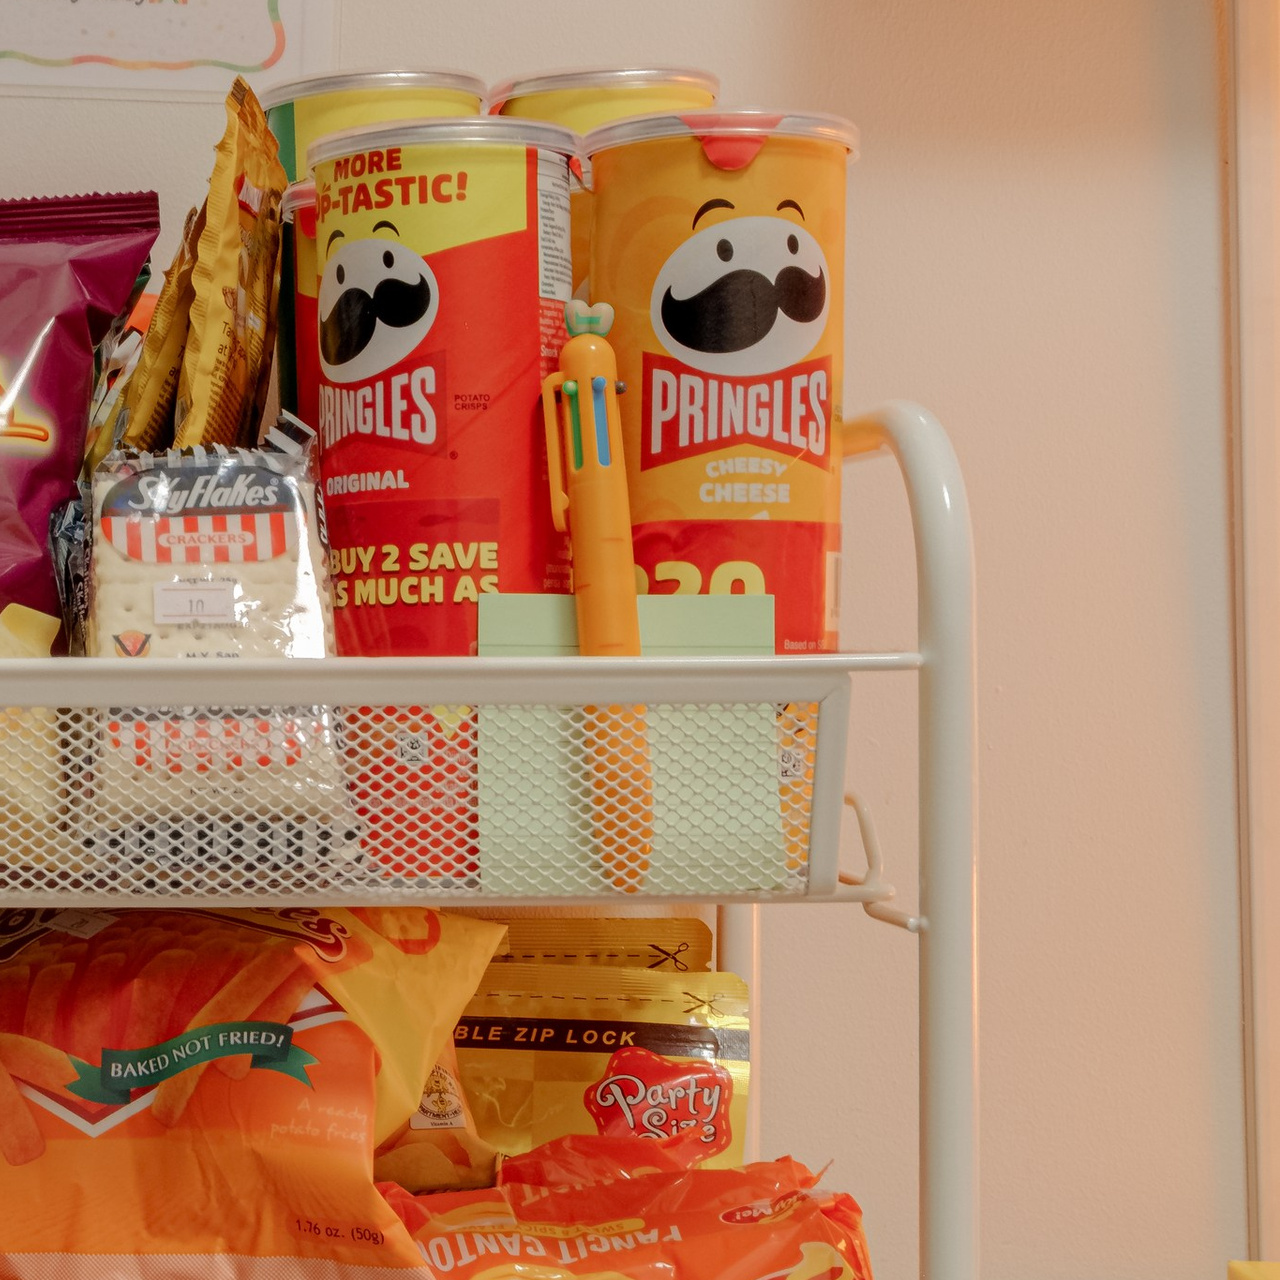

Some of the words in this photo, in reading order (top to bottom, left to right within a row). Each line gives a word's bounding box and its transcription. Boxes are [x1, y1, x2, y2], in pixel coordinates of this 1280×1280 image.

[334, 148, 401, 182] MORE
[454, 394, 490, 402] POTATO
[651, 368, 828, 456] PRINGLES
[706, 457, 787, 478] CHEESY
[128, 474, 278, 513] SkyFlakes
[327, 470, 409, 496] ORIGINAL
[699, 483, 790, 503] CHEESE
[166, 534, 246, 545] CRACKERS
[331, 546, 376, 575] BUY
[382, 544, 400, 571] 2
[409, 542, 498, 570] SAVE
[355, 576, 443, 605] MUCH
[455, 1026, 502, 1041] BLE
[515, 1028, 555, 1043] ZIP
[566, 1029, 636, 1046] LOCK
[110, 1054, 169, 1078] BAKED
[173, 1036, 212, 1061] NOT
[219, 1031, 284, 1048] FRIED!
[596, 1075, 721, 1128] Party
[296, 1220, 319, 1235] 1.76
[325, 1226, 345, 1239] oz.
[350, 1224, 385, 1245] (50g)
